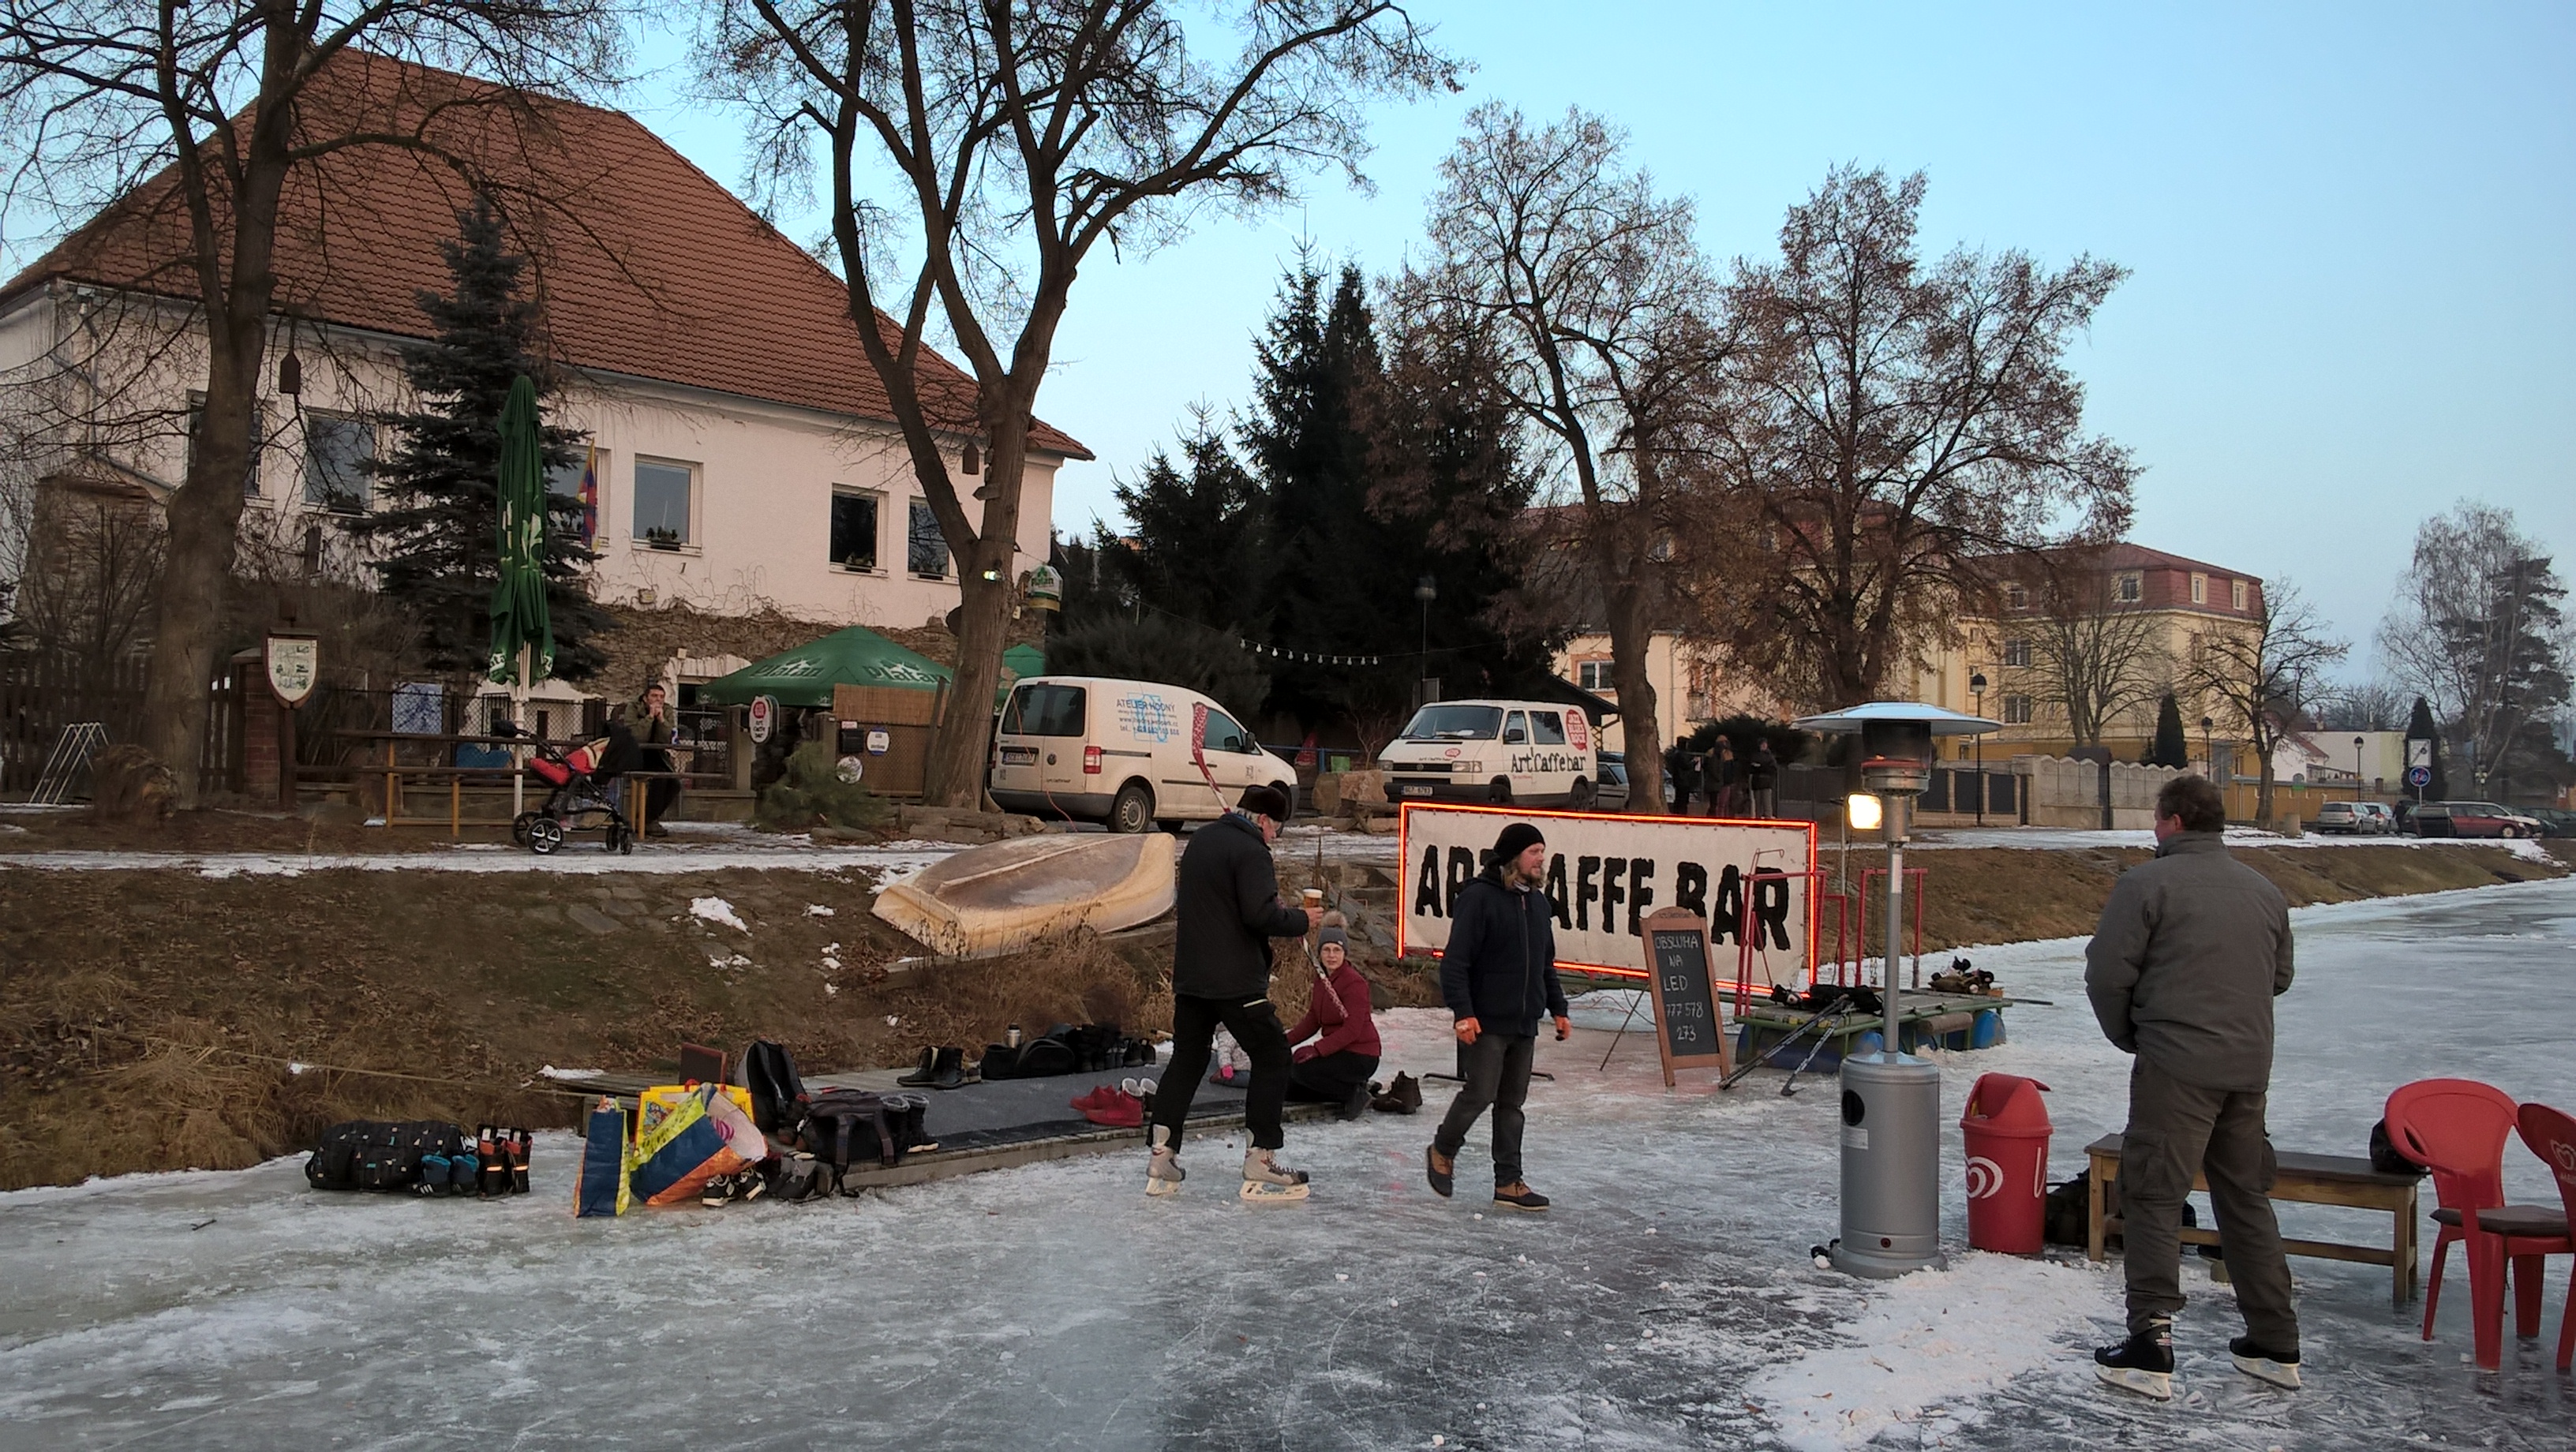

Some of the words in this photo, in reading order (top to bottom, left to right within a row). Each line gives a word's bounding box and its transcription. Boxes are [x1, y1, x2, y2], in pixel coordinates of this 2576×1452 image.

[1116, 699, 1148, 709] ATELIER
[1676, 861, 1791, 951] BAR
[1655, 936, 1698, 949] OBSLUHA
[1668, 954, 1683, 967] NA
[1663, 975, 1687, 992] LED
[1666, 1003, 1682, 1018] 777
[1685, 1001, 1703, 1018] 578
[1676, 1026, 1696, 1041] 273
